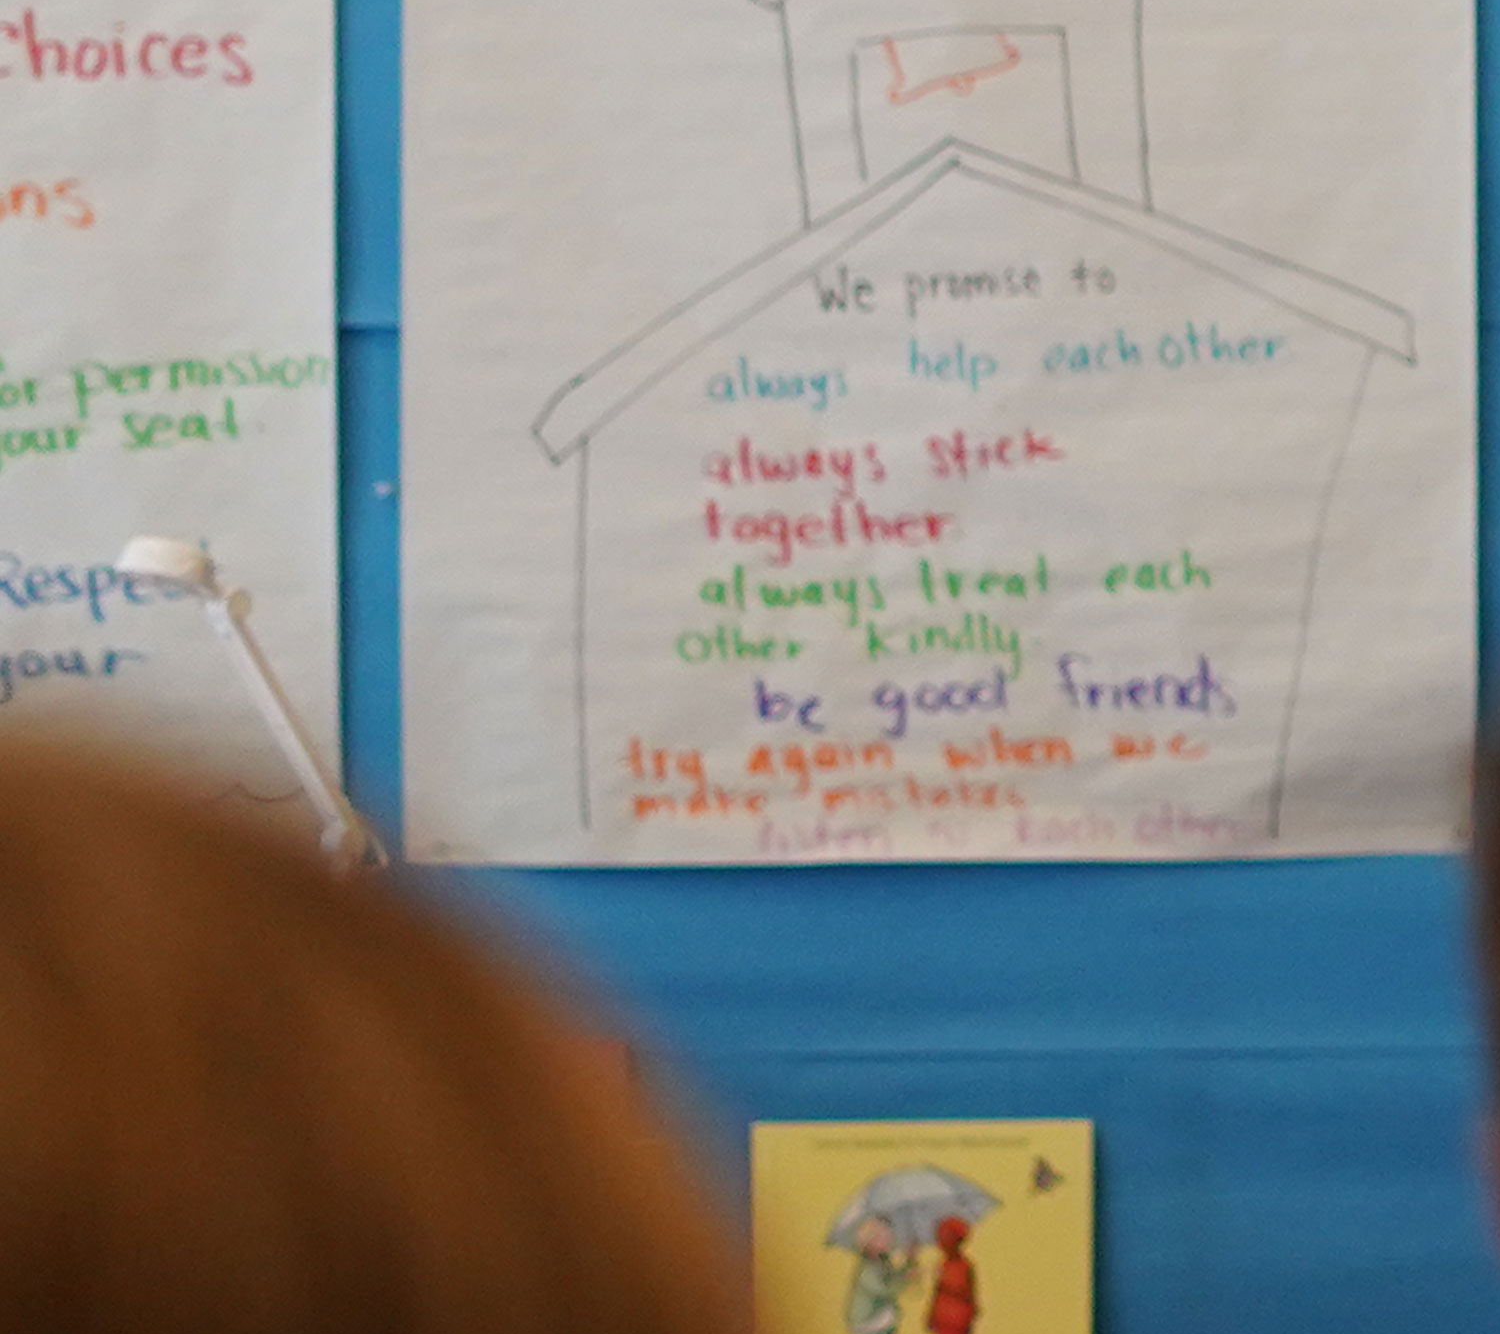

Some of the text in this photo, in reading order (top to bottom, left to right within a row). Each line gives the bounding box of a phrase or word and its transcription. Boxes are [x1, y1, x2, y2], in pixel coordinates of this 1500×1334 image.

[811, 260, 1118, 320] We promise to
[705, 355, 850, 411] always
[907, 337, 991, 393] help
[1041, 326, 1142, 374] each
[700, 435, 888, 499] always
[702, 497, 960, 567] together
[698, 549, 1214, 628] always treat each
[752, 651, 1239, 739] be good friends
[942, 727, 1074, 769] when
